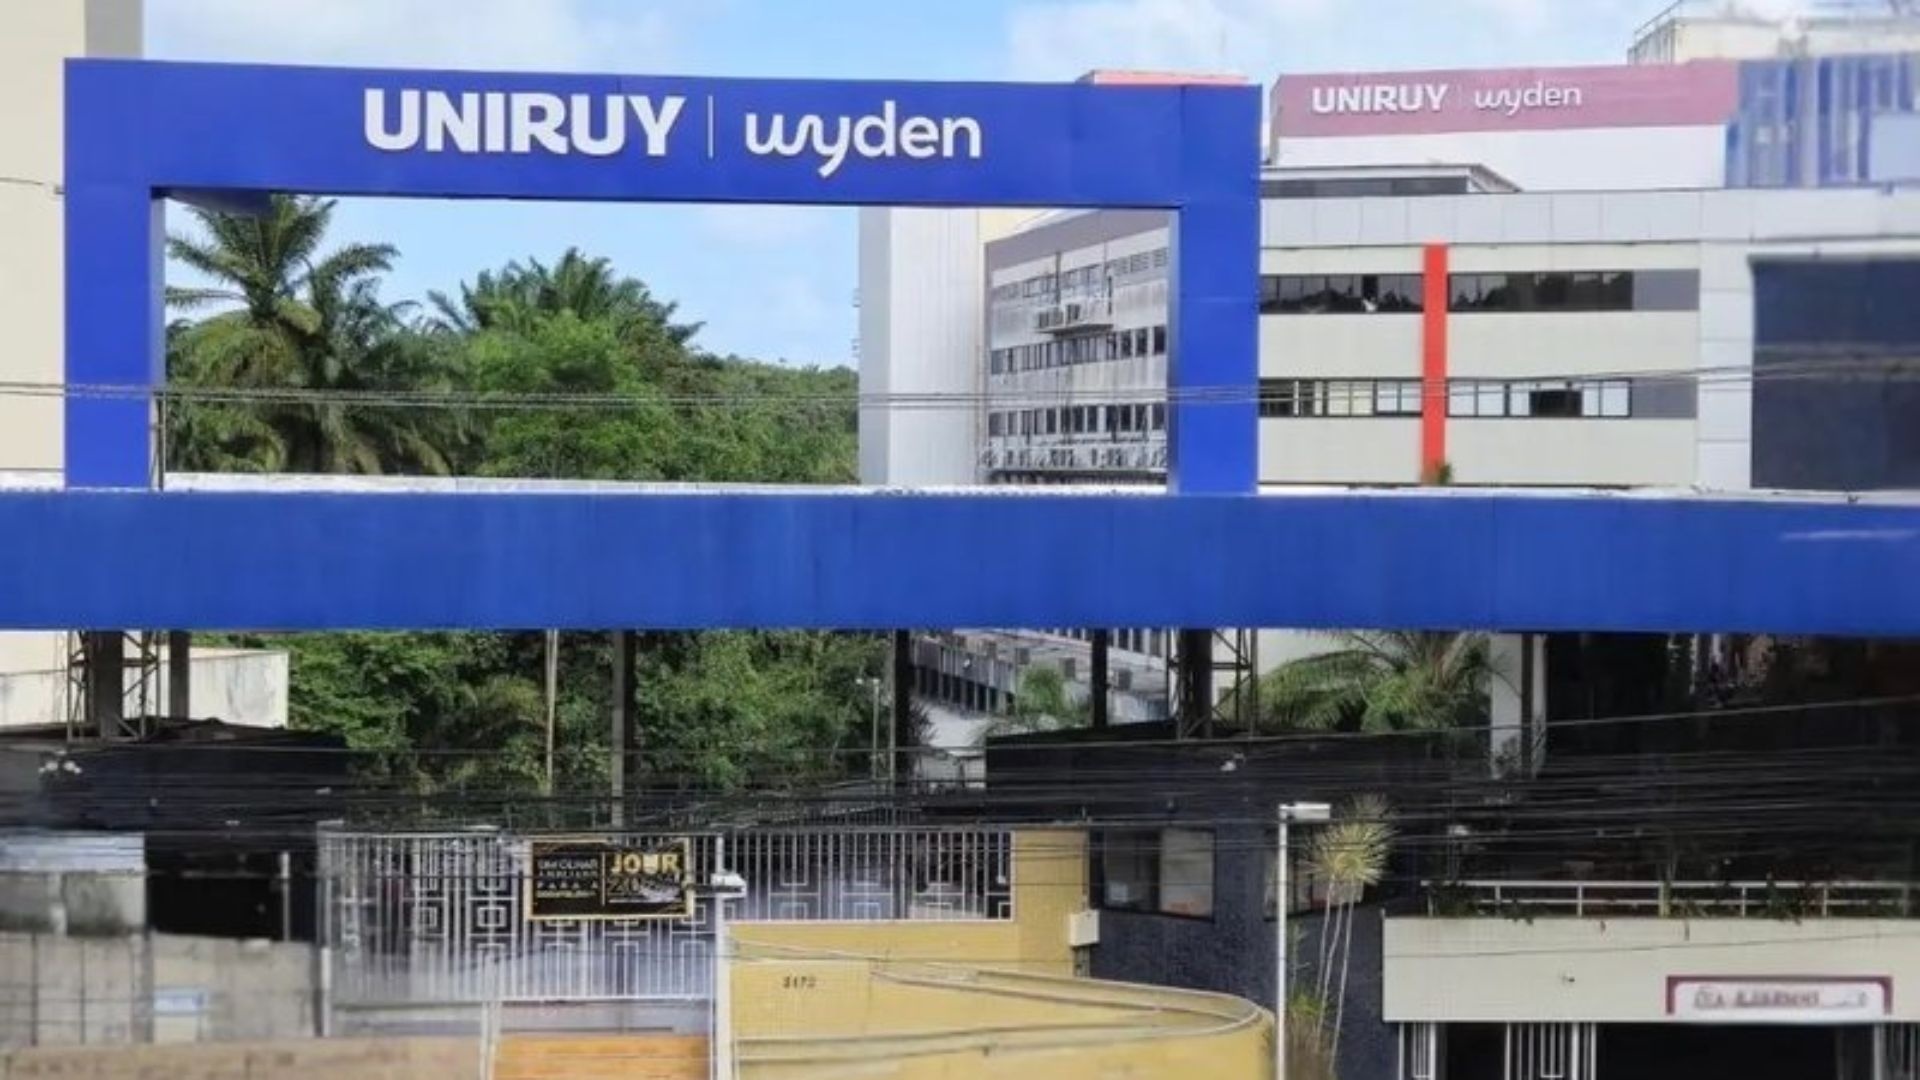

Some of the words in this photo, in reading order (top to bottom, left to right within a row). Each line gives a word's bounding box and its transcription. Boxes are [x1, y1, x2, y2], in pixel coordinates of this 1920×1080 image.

[1311, 83, 1449, 114] UNIRUY
[1473, 80, 1582, 116] wyden
[364, 88, 685, 156] UNIRUY
[745, 100, 981, 177] wyden
